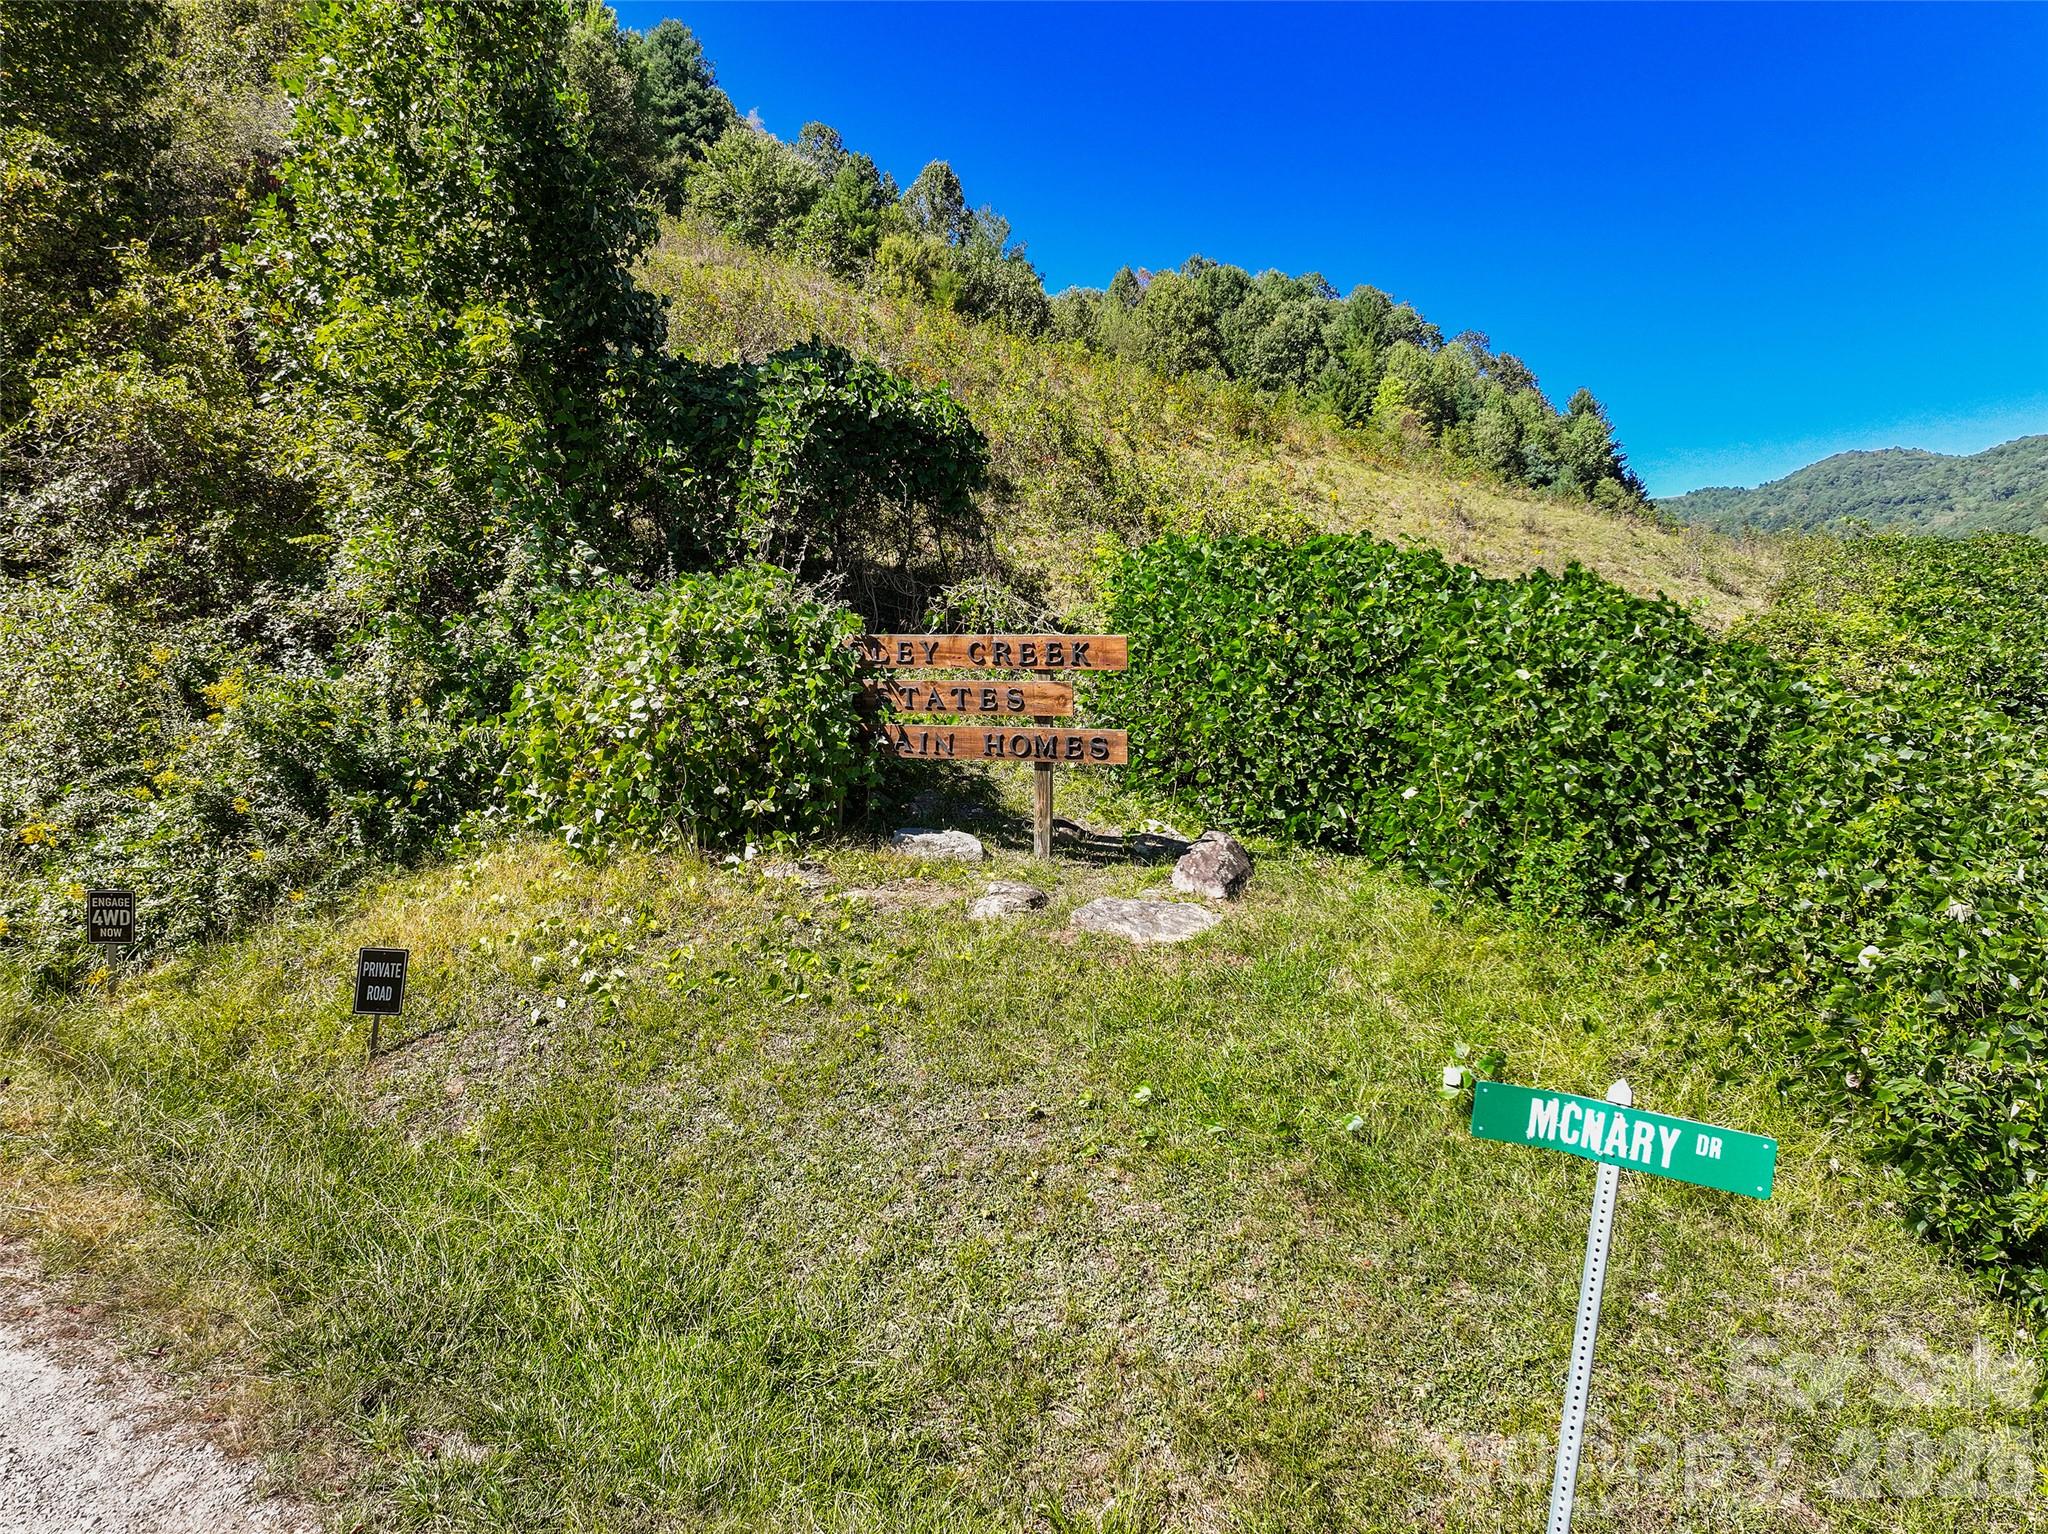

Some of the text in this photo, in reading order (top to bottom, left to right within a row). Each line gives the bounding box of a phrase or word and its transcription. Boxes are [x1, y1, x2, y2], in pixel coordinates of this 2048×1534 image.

[967, 640, 1092, 667] CREEK
[983, 733, 1110, 760] HOMES
[91, 897, 130, 907] ENGAGE
[91, 909, 131, 926] 4WD
[99, 928, 122, 937] NOW
[362, 961, 402, 978] PRIVATE
[366, 985, 392, 1001] ROAD
[1526, 1097, 1722, 1169] MCNARY DR
